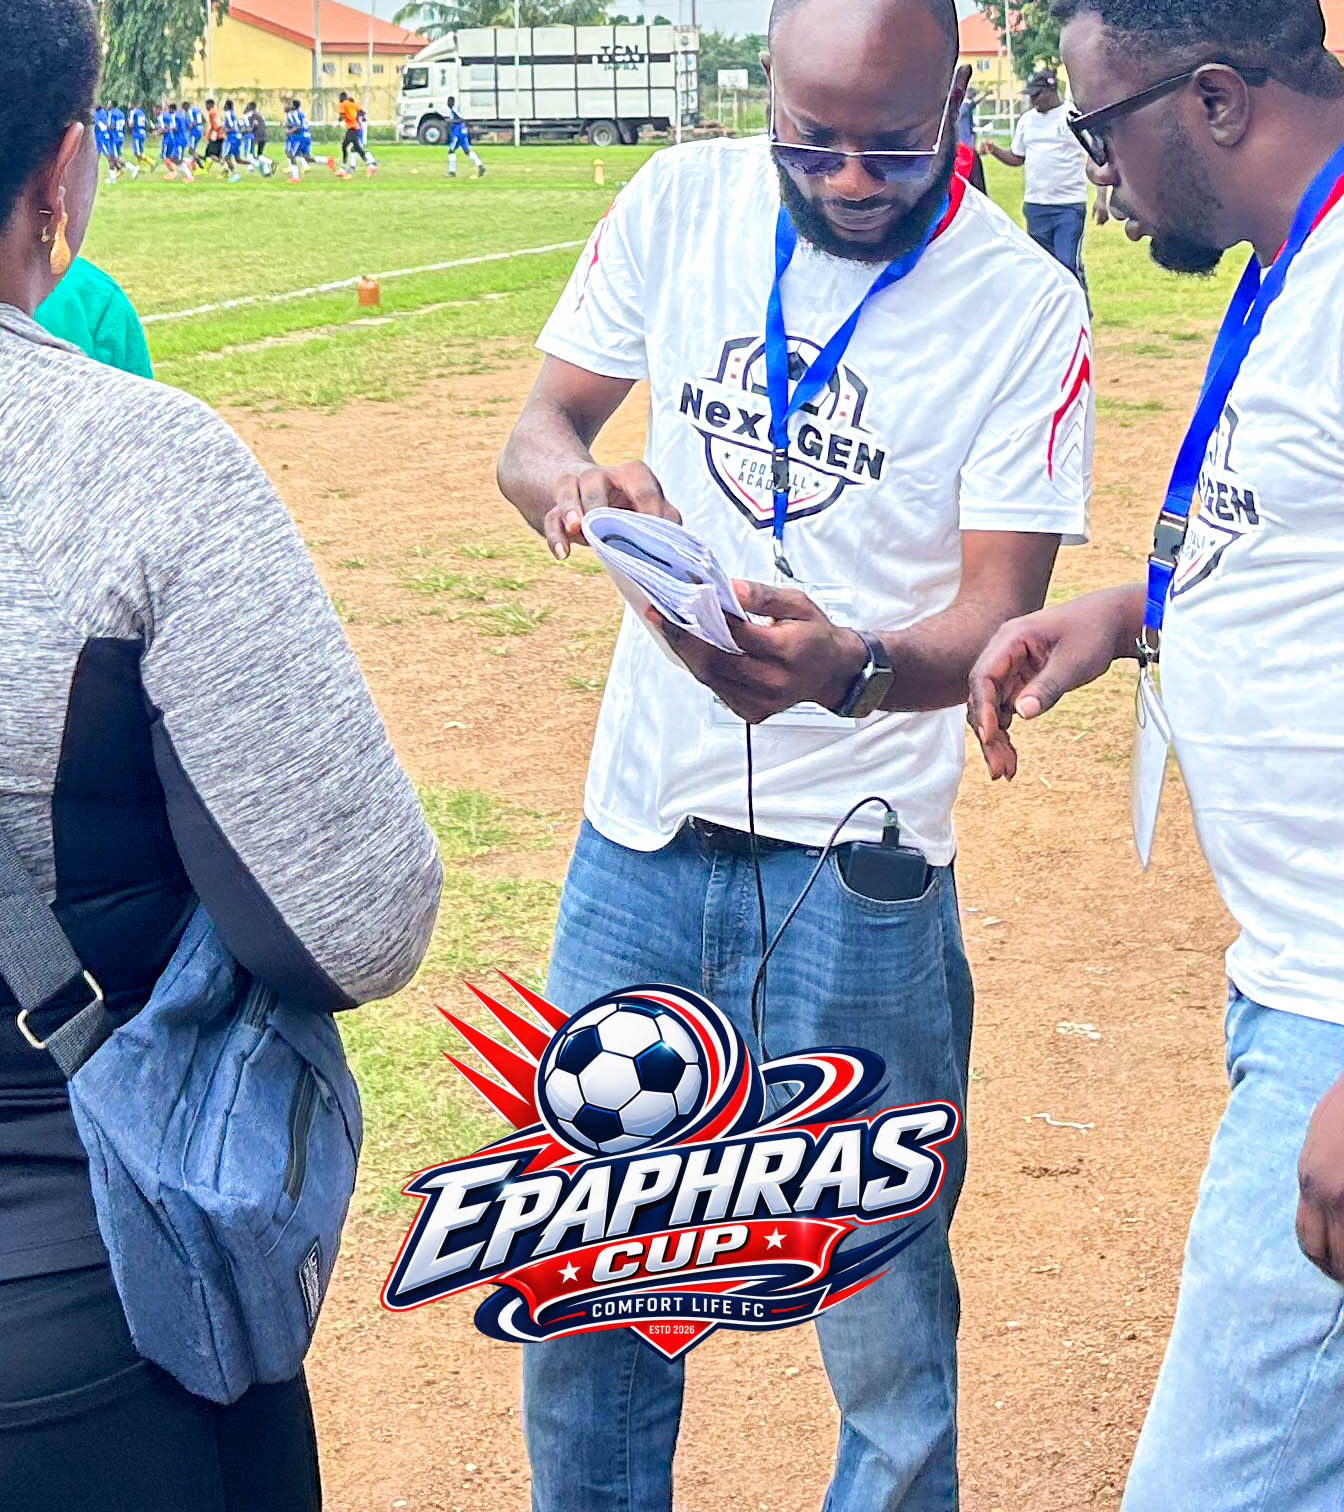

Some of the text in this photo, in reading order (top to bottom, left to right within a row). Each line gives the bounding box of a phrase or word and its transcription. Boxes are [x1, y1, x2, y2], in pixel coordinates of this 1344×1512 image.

[679, 382, 885, 481] NeXGEN
[738, 472, 800, 499] ACADY
[741, 459, 806, 489] FOOLL
